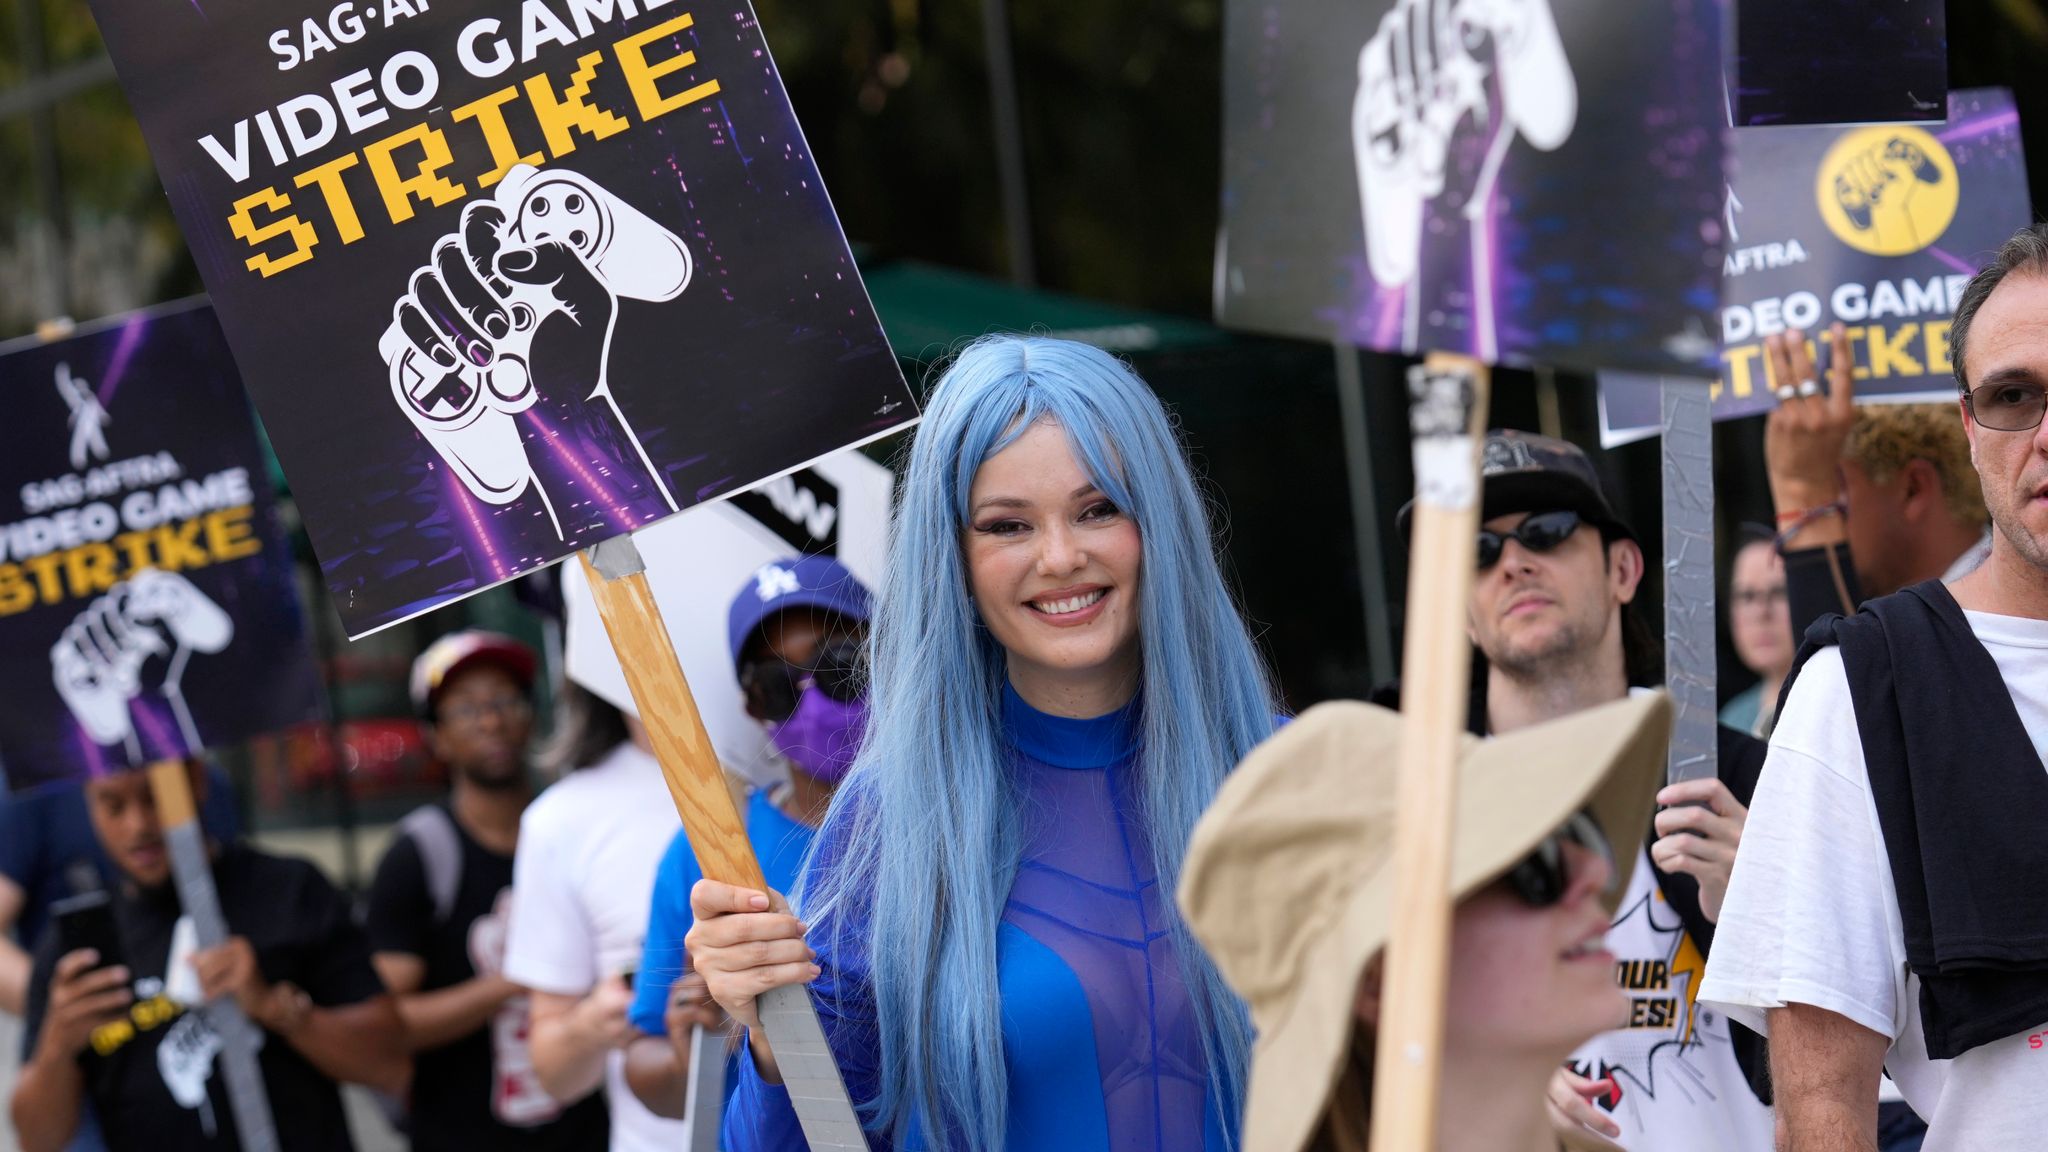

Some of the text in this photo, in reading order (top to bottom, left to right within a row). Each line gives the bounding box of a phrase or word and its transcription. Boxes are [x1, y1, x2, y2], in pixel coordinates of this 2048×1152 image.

[197, 0, 674, 184] VIDEO GAM
[226, 12, 721, 279] STRIKE
[0, 505, 262, 616] STRIKE
[120, 466, 254, 531] GAME
